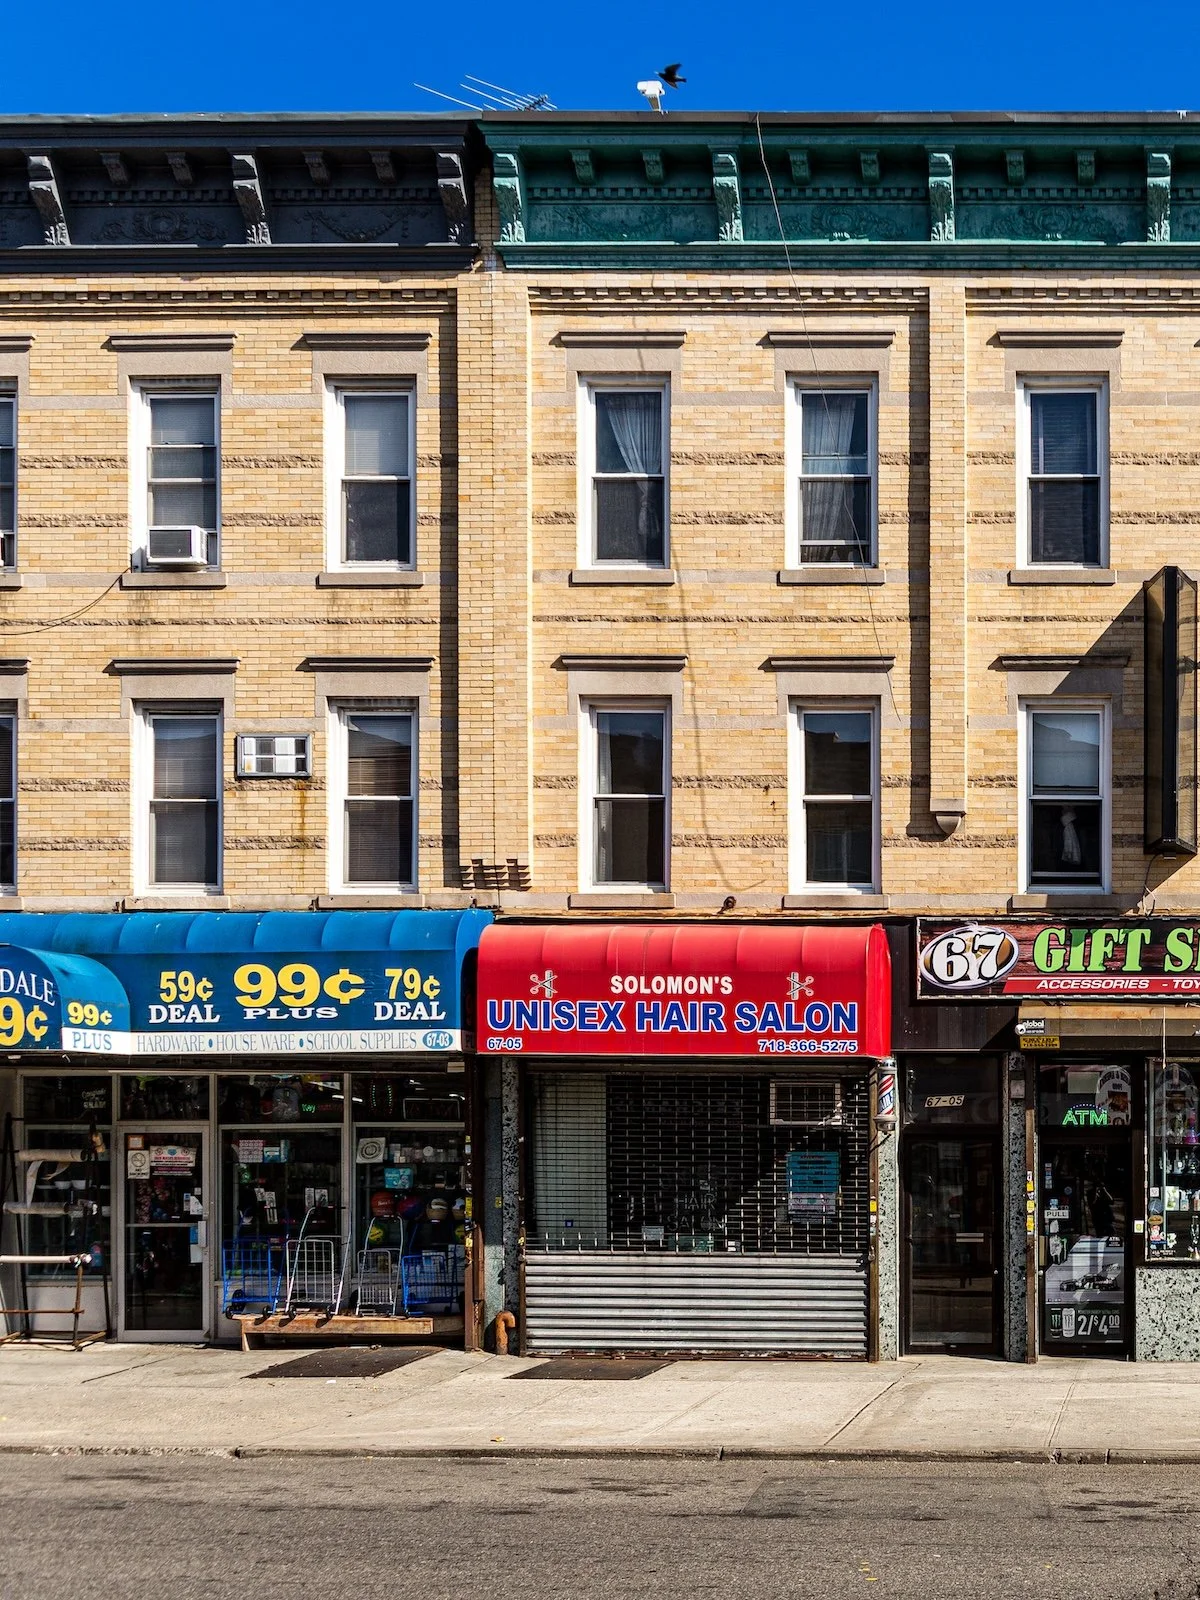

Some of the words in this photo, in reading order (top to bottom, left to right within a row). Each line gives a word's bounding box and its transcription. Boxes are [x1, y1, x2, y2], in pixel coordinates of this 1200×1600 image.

[931, 933, 1006, 983] 67
[1032, 927, 1152, 974] GIFT
[159, 971, 214, 1003] 59¢
[233, 963, 366, 1008] 99¢
[385, 968, 440, 1000] 79¢
[610, 975, 733, 995] SOLOMON'S
[1036, 978, 1150, 990] ACCESSORIES
[67, 1002, 113, 1026] 99¢
[148, 1005, 220, 1023] DEAL
[243, 1007, 338, 1020] PLUS
[374, 1002, 446, 1021] DEAL
[486, 1000, 626, 1032] UNISEX
[635, 1001, 727, 1033] HAIR
[734, 1001, 859, 1034] SALON
[72, 1031, 113, 1050] PLUS
[137, 1035, 205, 1051] HARDWARE
[217, 1034, 257, 1051] HOUSE
[260, 1034, 296, 1050] WARE
[306, 1033, 357, 1050] SCHOOL
[360, 1032, 417, 1049] SUPPLIES
[425, 1033, 450, 1047] 67-03
[487, 1037, 522, 1051] 67-05
[757, 1039, 859, 1054] 718-366-5275
[926, 1096, 964, 1107] 67-05
[1062, 1109, 1109, 1126] ATM
